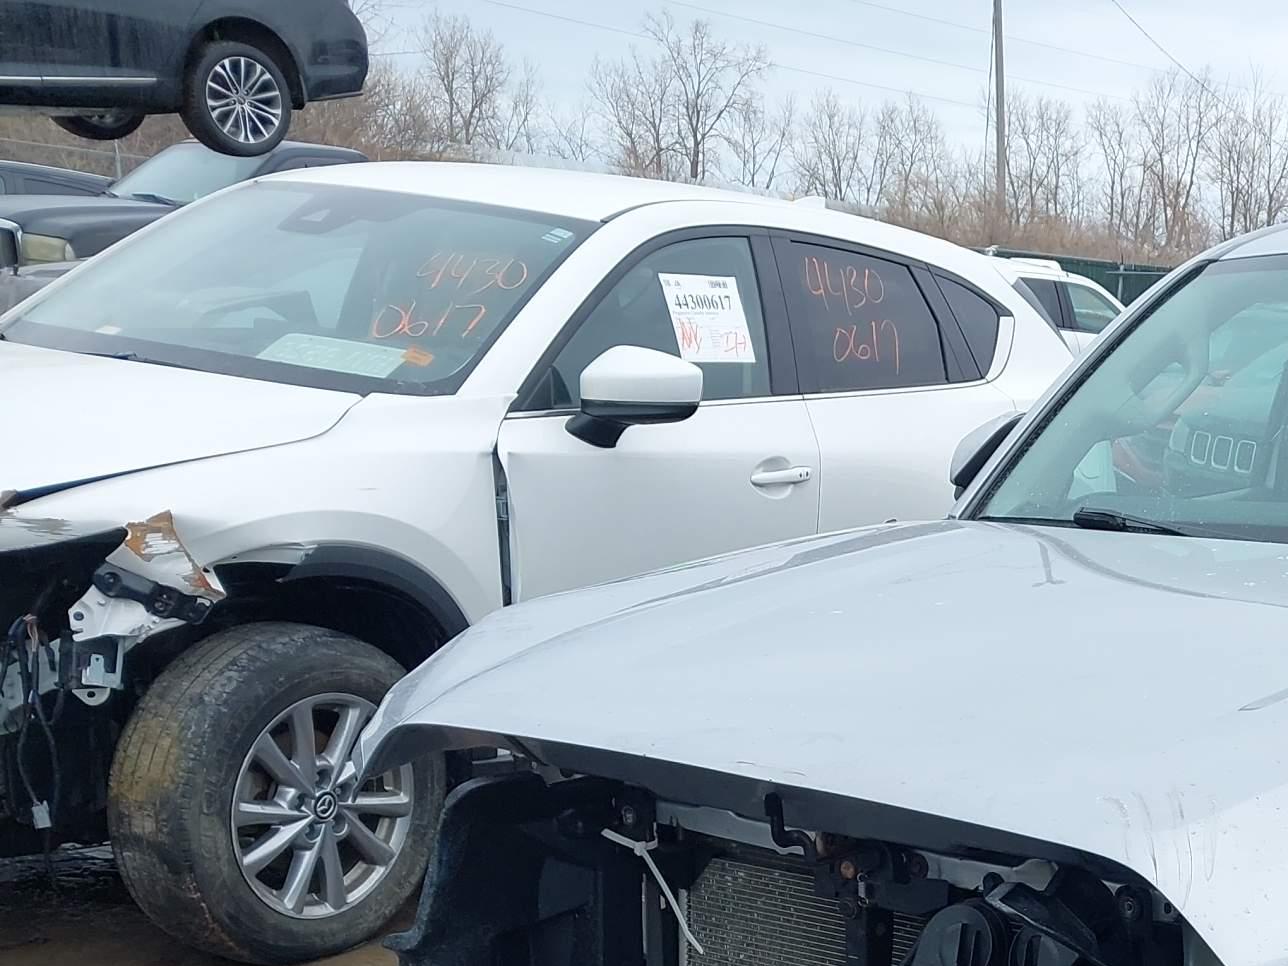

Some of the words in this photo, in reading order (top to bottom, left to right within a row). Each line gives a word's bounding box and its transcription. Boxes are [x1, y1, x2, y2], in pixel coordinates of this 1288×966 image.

[674, 293, 732, 311] 44300617
[804, 256, 884, 317] 4430
[372, 299, 487, 339] 0617
[833, 319, 900, 376] 0617
